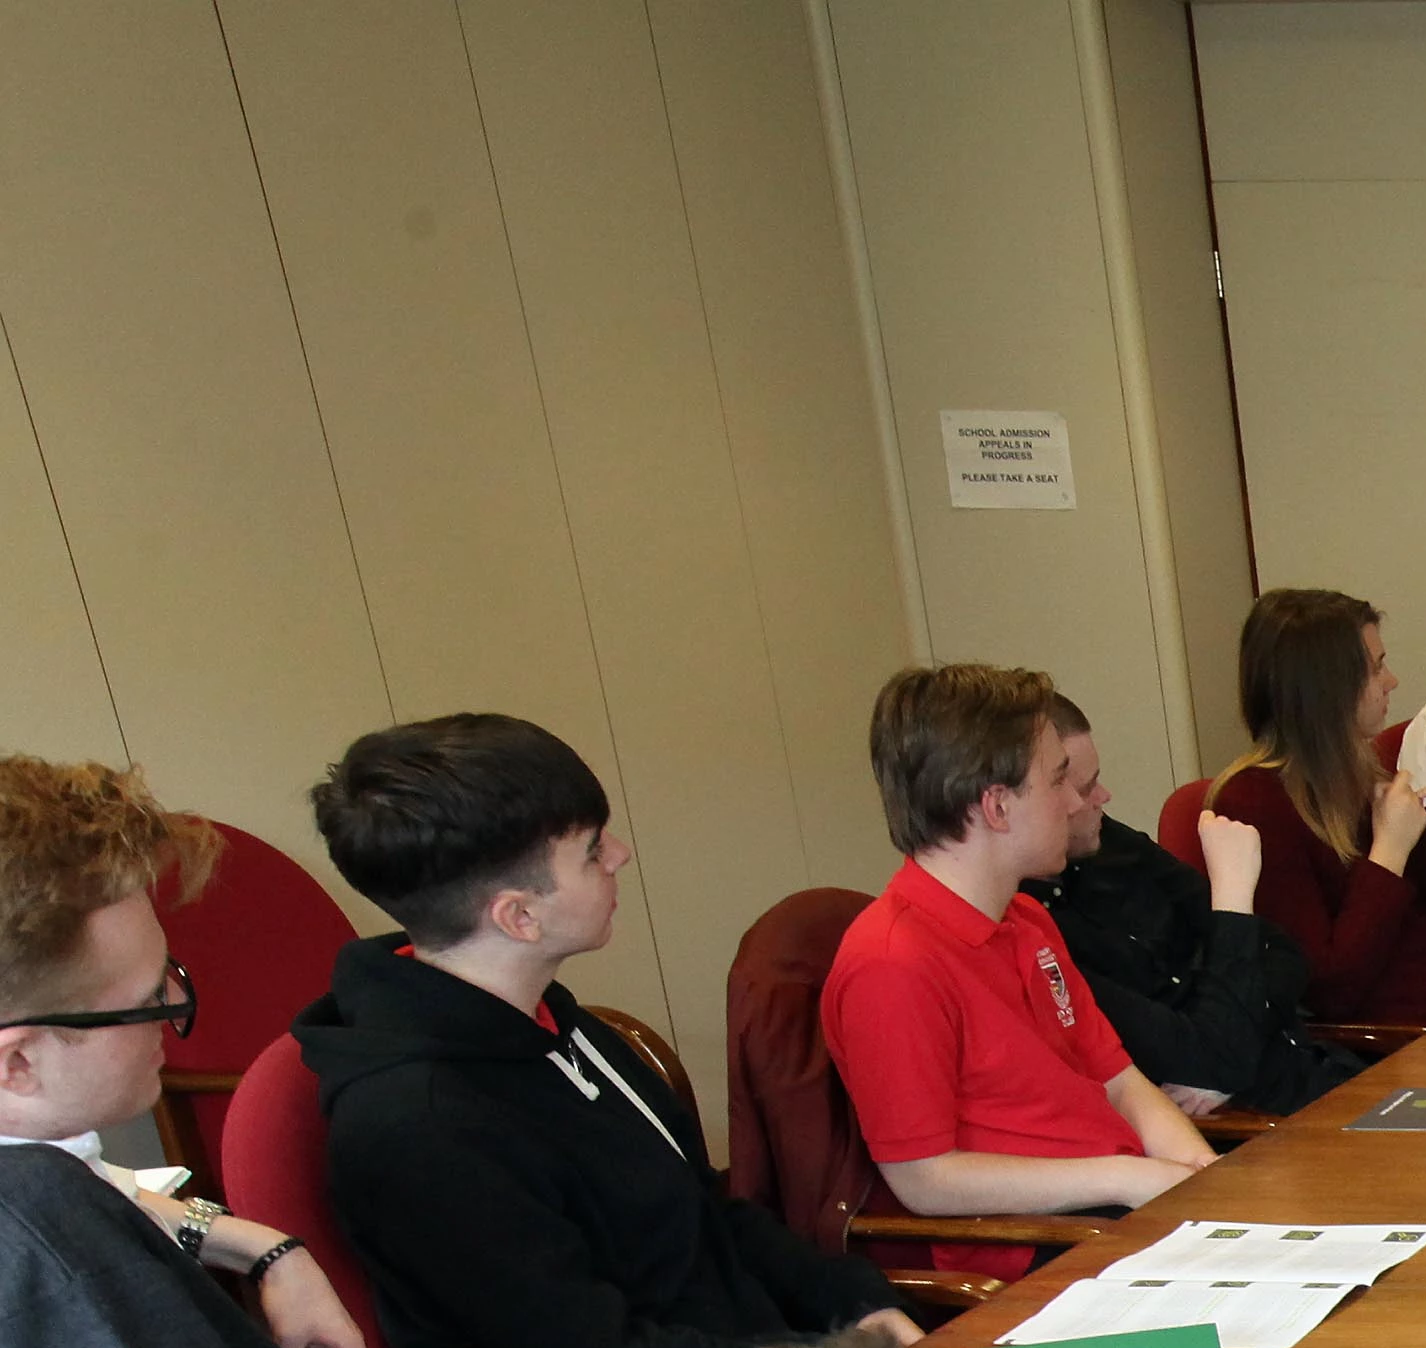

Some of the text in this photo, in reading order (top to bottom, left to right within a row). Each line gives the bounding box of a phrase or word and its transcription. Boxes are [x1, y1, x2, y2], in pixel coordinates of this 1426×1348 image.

[958, 428, 1051, 438] SCHOOL ADMISSION
[979, 440, 1033, 449] APPEALS IN
[982, 451, 1033, 460] PROGRESS
[962, 473, 1059, 484] PLEASE TAKE A SEAT
